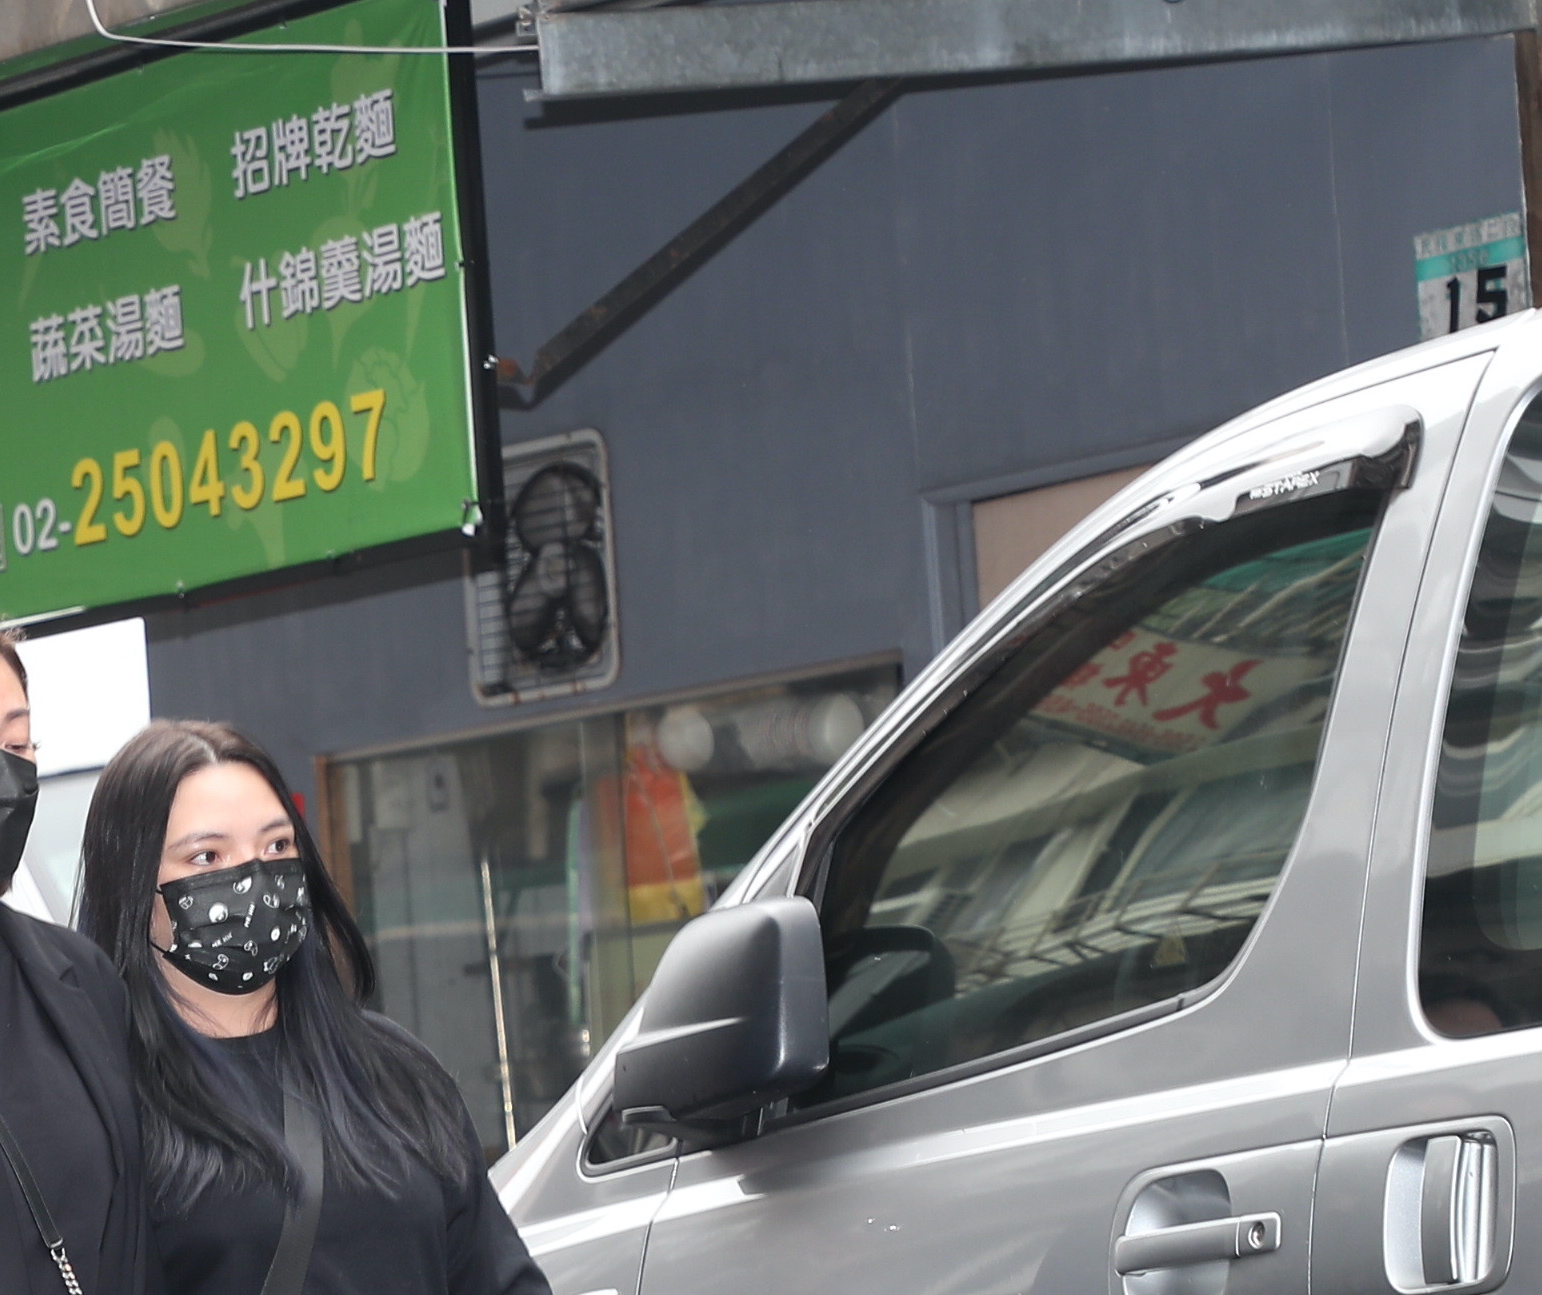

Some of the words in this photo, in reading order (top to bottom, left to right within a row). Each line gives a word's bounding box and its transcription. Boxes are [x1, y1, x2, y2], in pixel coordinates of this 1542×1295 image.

[22, 154, 177, 255] 素食簡餐
[231, 88, 396, 198] 招牌乾麵
[30, 284, 184, 383] 蔬菜湯麵
[240, 210, 445, 330] 什錦羹湯麵
